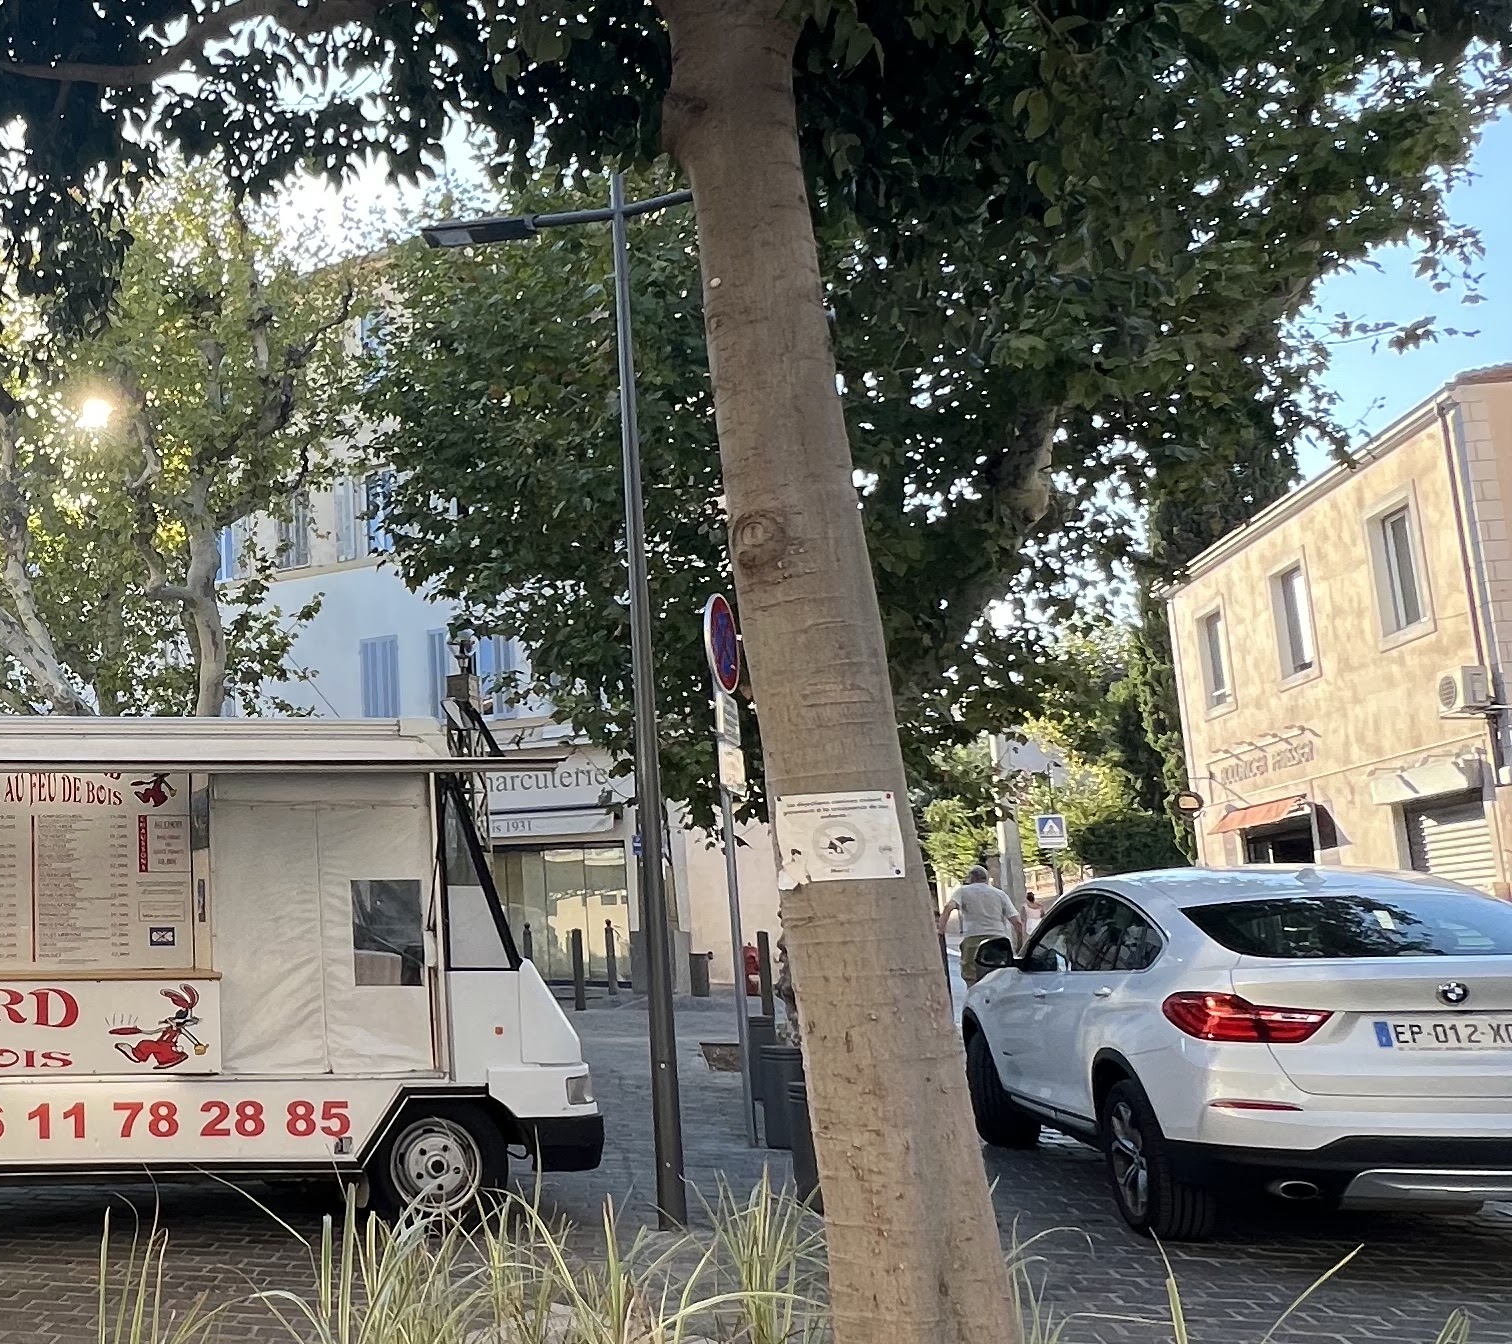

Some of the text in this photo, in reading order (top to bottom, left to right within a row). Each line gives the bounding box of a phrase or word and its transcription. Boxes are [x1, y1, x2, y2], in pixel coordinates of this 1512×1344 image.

[4, 772, 25, 803] AU
[29, 772, 57, 807] FEU
[62, 774, 82, 804] DE
[86, 781, 123, 806] BOIS
[506, 820, 533, 833] 1931
[27, 1101, 86, 1140] 11
[113, 1101, 180, 1138] 78
[200, 1100, 266, 1137] 28
[287, 1100, 351, 1138] 85
